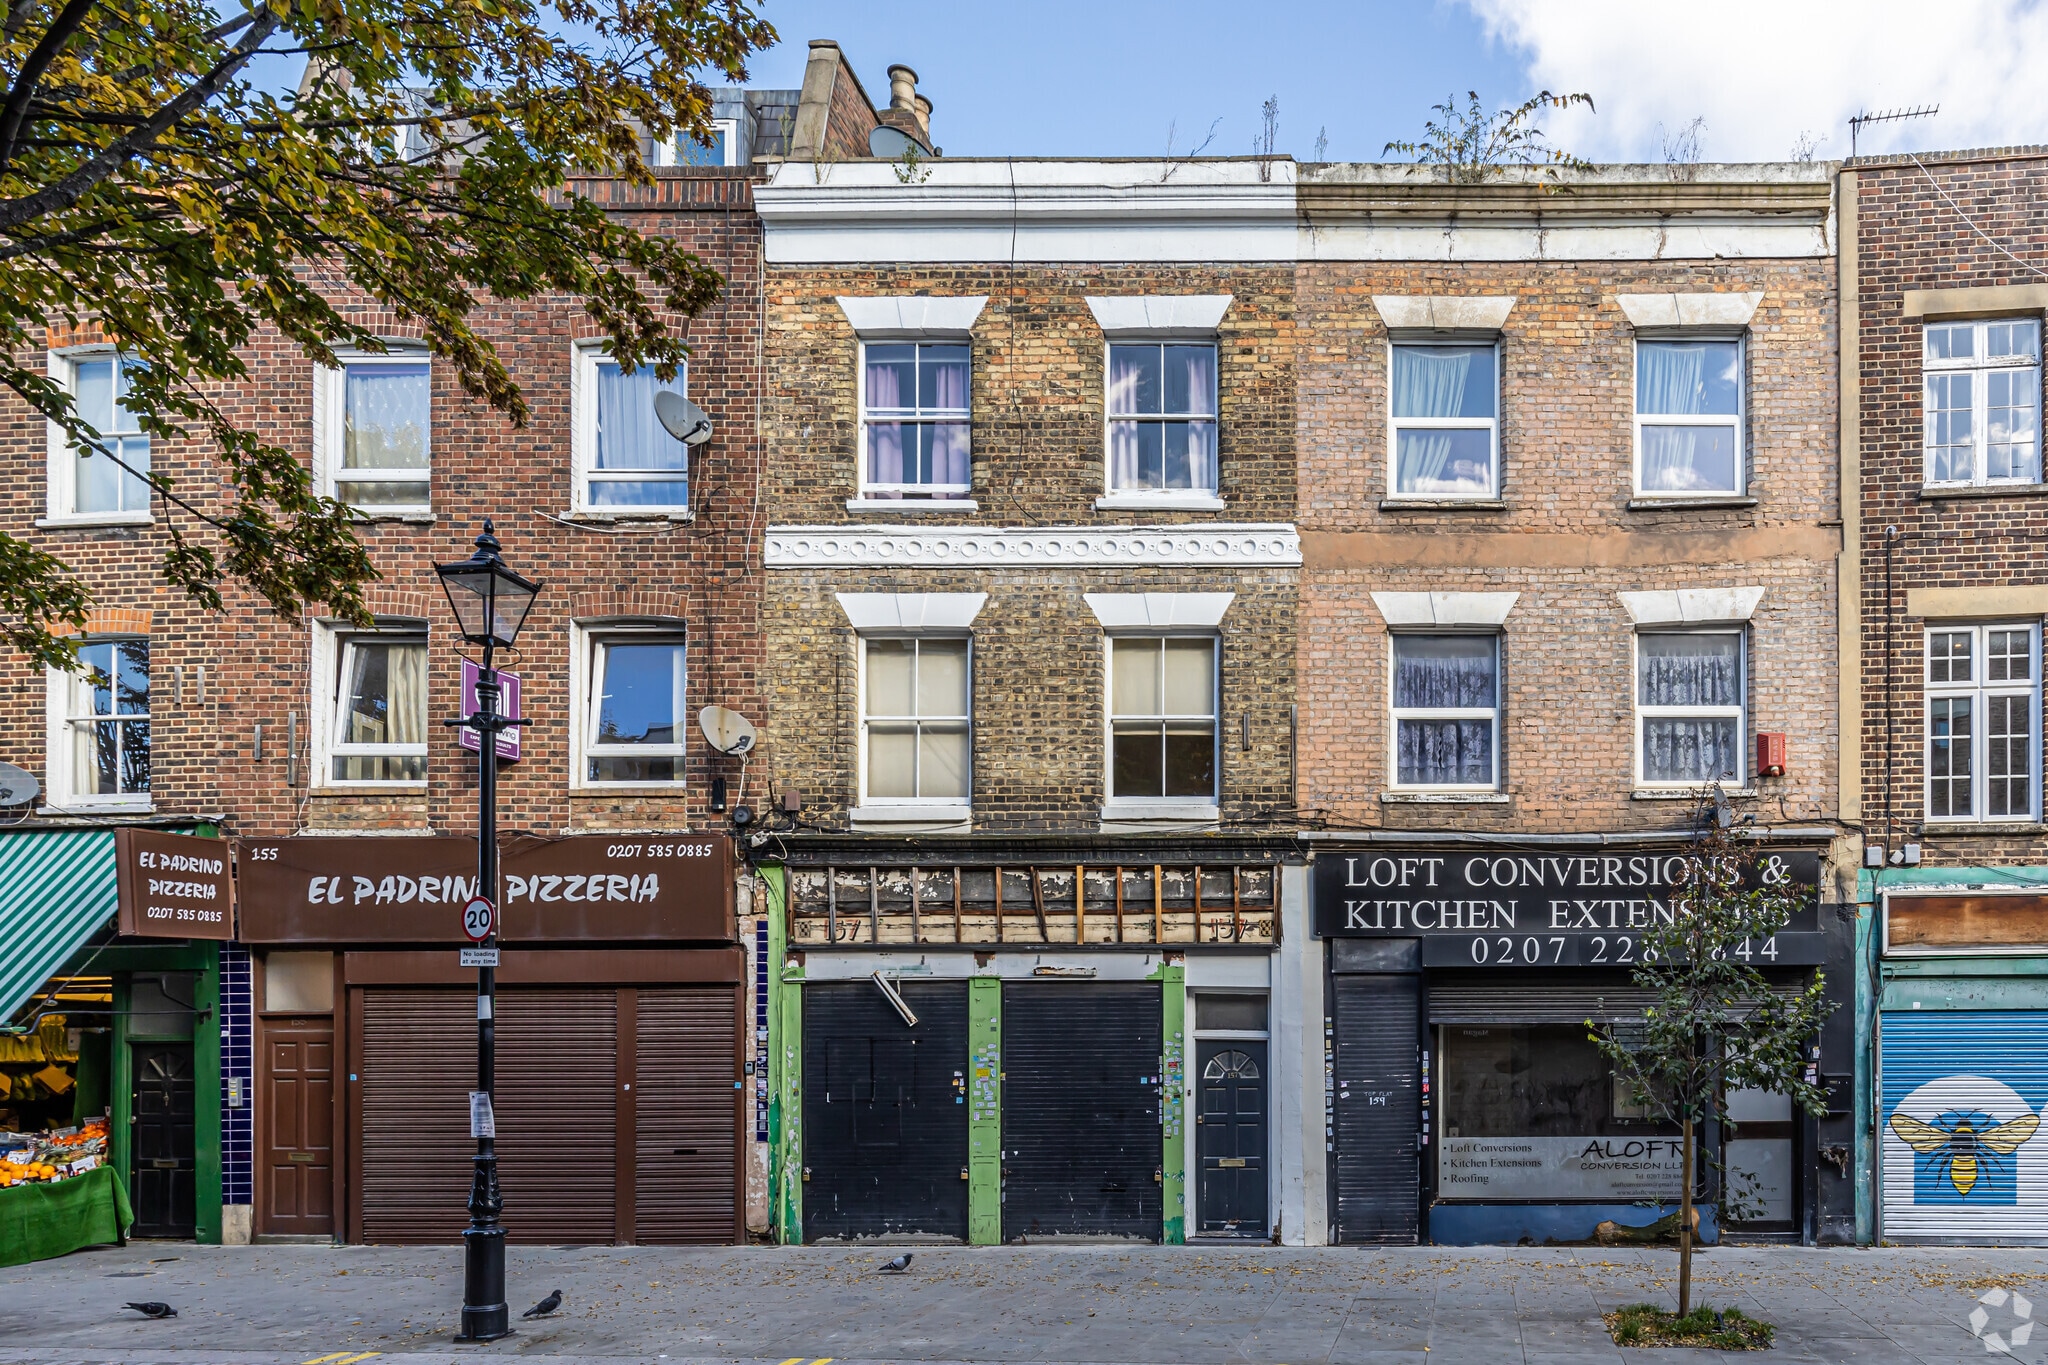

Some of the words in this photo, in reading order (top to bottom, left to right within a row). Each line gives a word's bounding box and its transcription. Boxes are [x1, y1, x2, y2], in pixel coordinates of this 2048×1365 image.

[251, 847, 279, 861] 155
[607, 844, 643, 858] 0207
[647, 844, 674, 858] 585
[677, 843, 713, 857] 0885
[139, 851, 157, 869] EL
[159, 853, 223, 875] PADRINO
[1345, 857, 1444, 887] LOFT
[1761, 855, 1792, 885] &
[148, 878, 217, 900] PIZZERIA
[308, 876, 344, 905] EL
[352, 875, 480, 906] PADRIN
[505, 873, 660, 904] PIZZERIA
[147, 906, 174, 919] 0207
[176, 908, 196, 921] 585
[197, 910, 222, 922] 0885
[466, 908, 490, 929] 20
[1344, 900, 1519, 929] KITCHEN
[1471, 936, 1566, 964] 0207
[1369, 1097, 1386, 1106] 159
[1450, 1143, 1470, 1153] Loft
[1473, 1143, 1533, 1153] Conversions
[1450, 1158, 1488, 1168] Kitchen
[1490, 1158, 1542, 1168] Extensions
[1580, 1162, 1661, 1170] CONVERSION
[1450, 1174, 1490, 1185] Roofing
